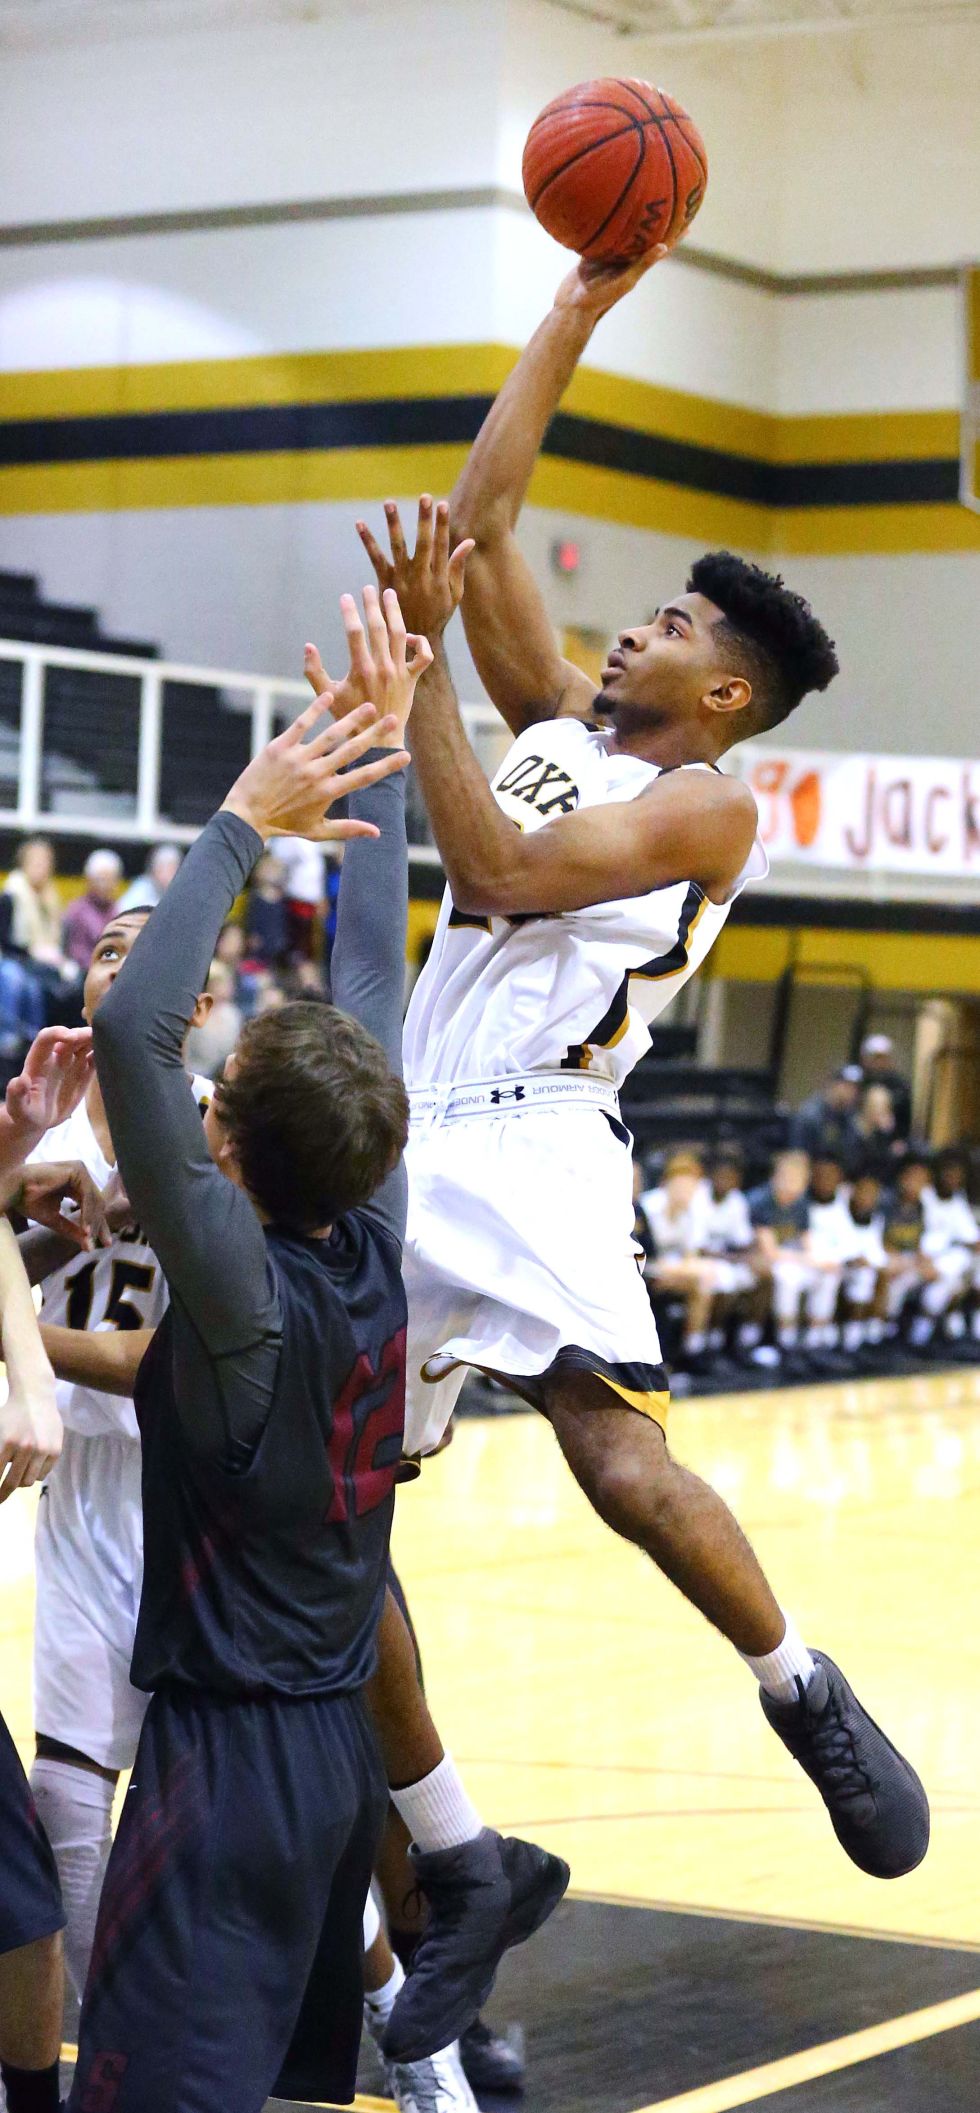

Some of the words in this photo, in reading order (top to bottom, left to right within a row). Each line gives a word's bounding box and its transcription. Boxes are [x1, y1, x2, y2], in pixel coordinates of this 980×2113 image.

[533, 1084, 584, 1096] ARMOUR
[64, 1258, 156, 1331] 15
[324, 1326, 407, 1523] 12
